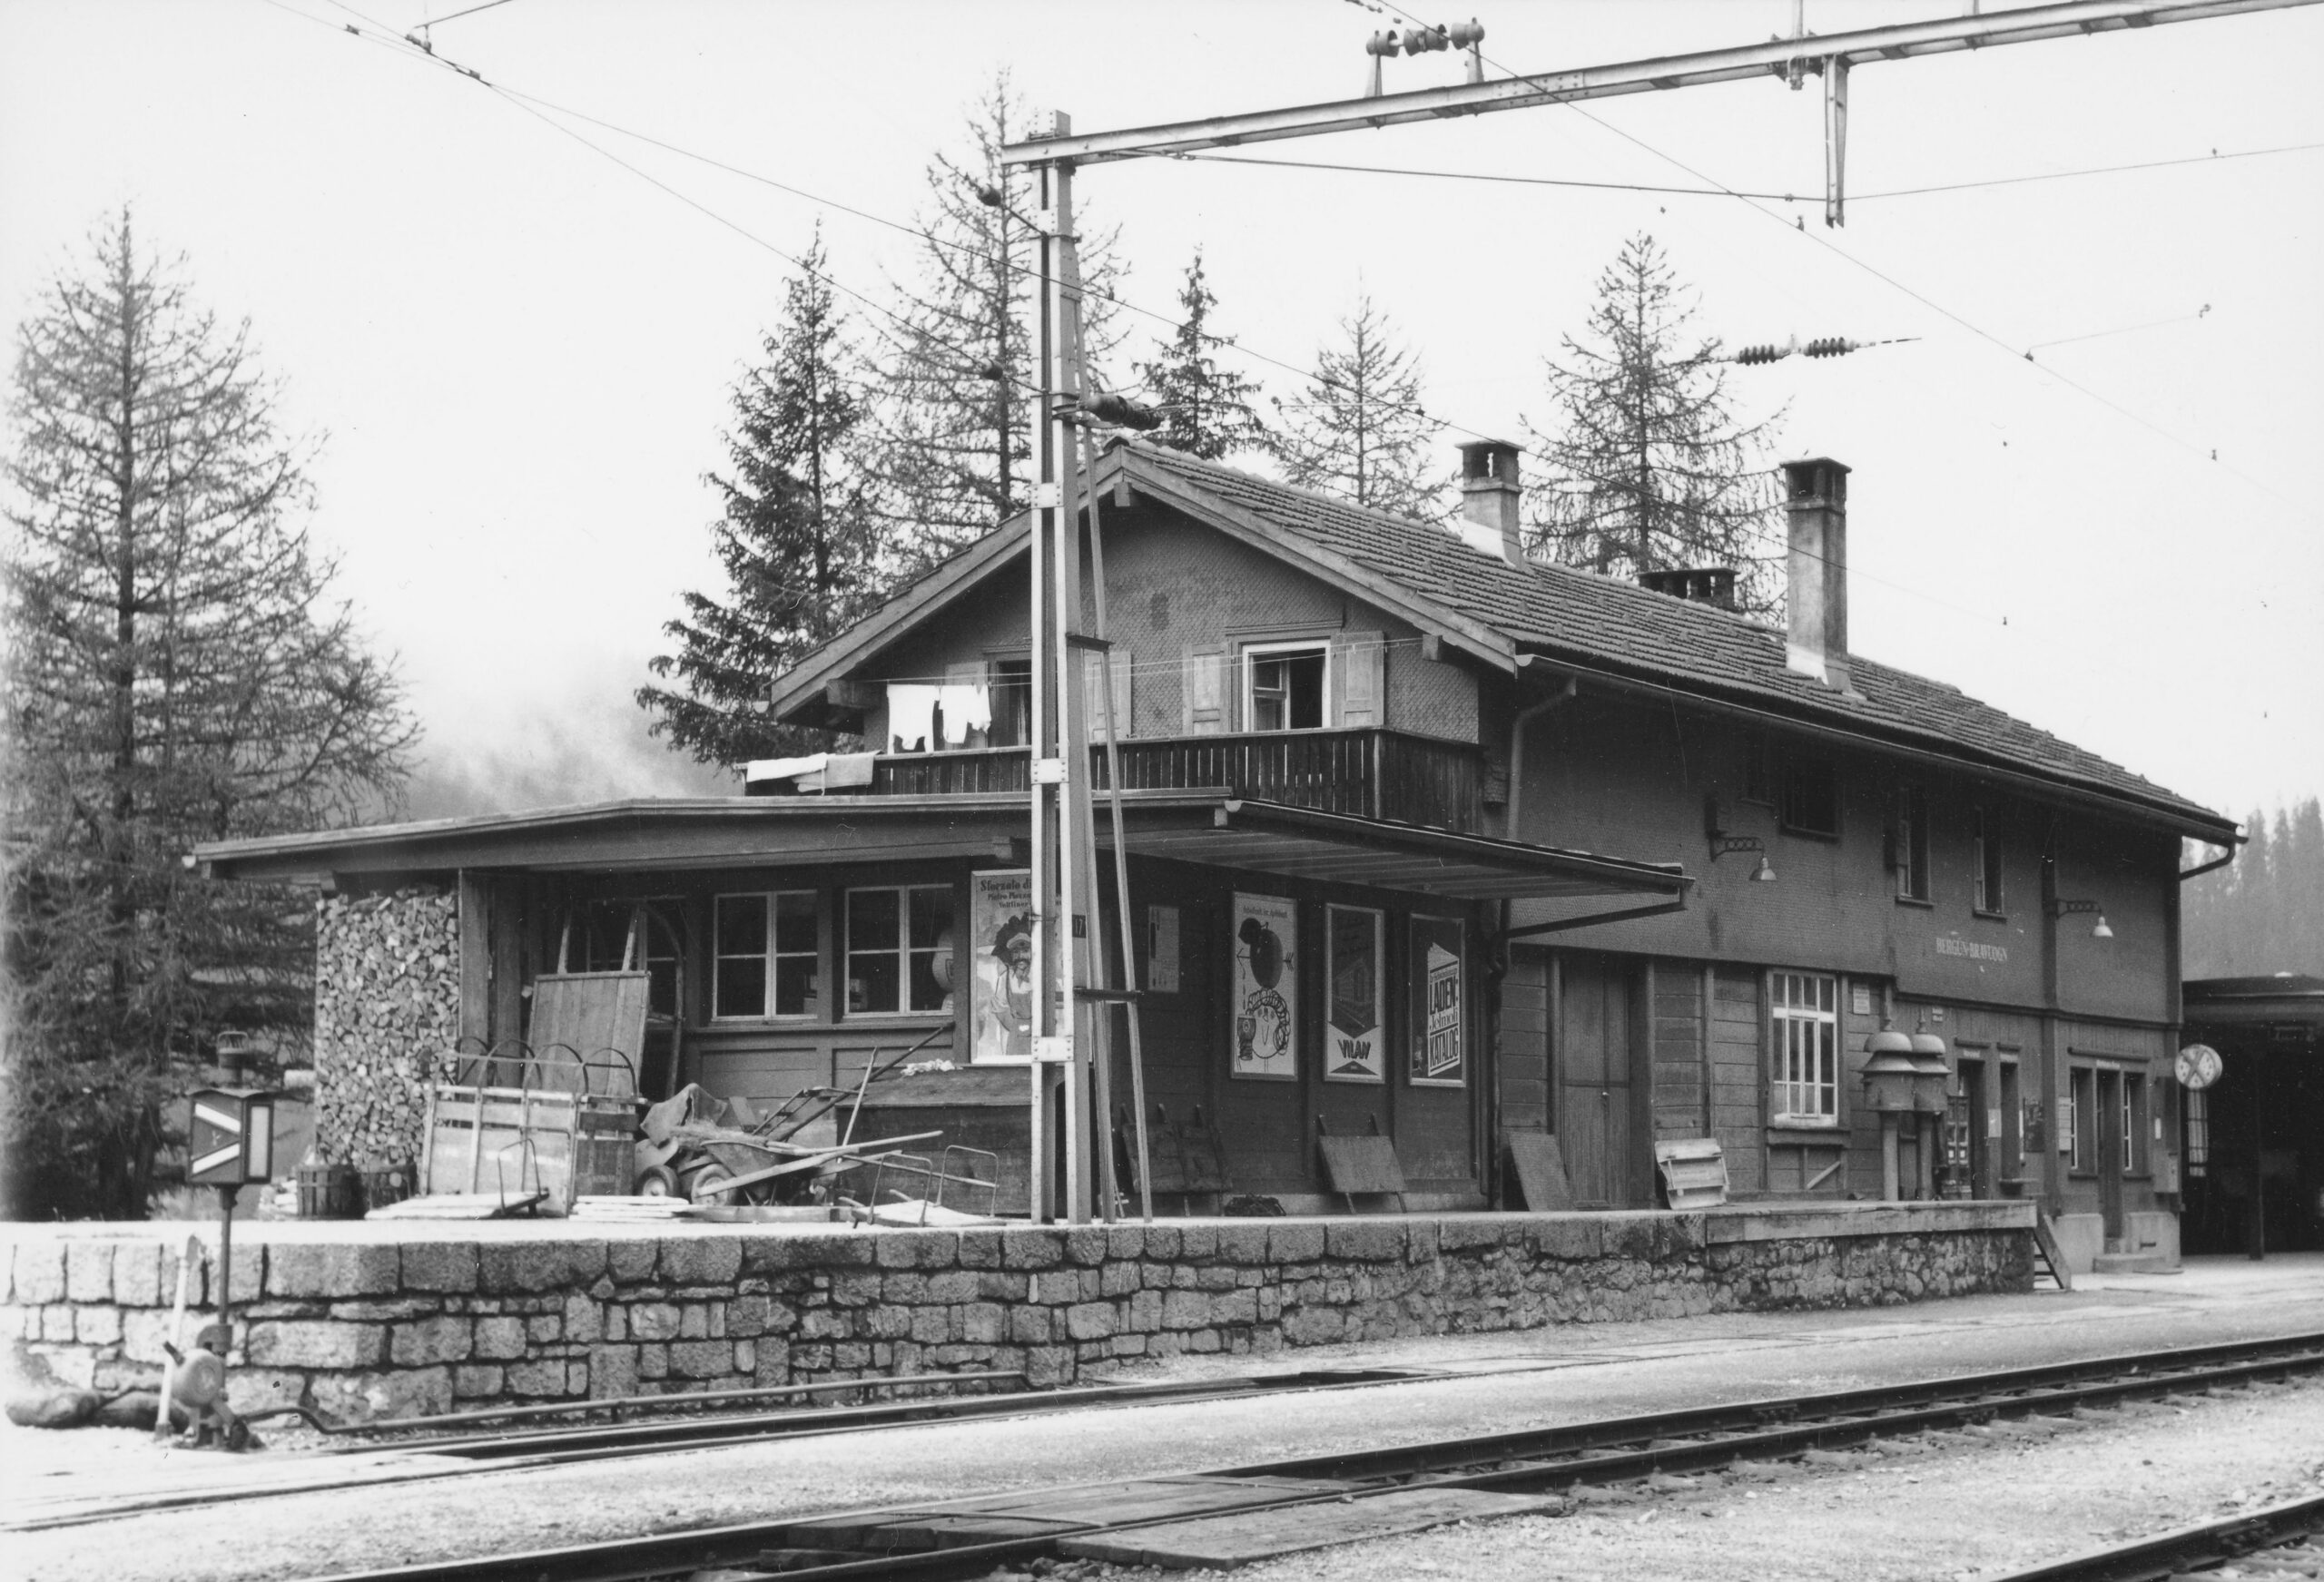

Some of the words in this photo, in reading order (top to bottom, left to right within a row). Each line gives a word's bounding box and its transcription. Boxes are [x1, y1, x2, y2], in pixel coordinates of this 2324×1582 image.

[980, 879, 1020, 891] Sforzato
[1429, 1007, 1459, 1030] Jelmoli
[1337, 1039, 1371, 1060] VILAN
[1429, 1027, 1459, 1067] KATALOG
